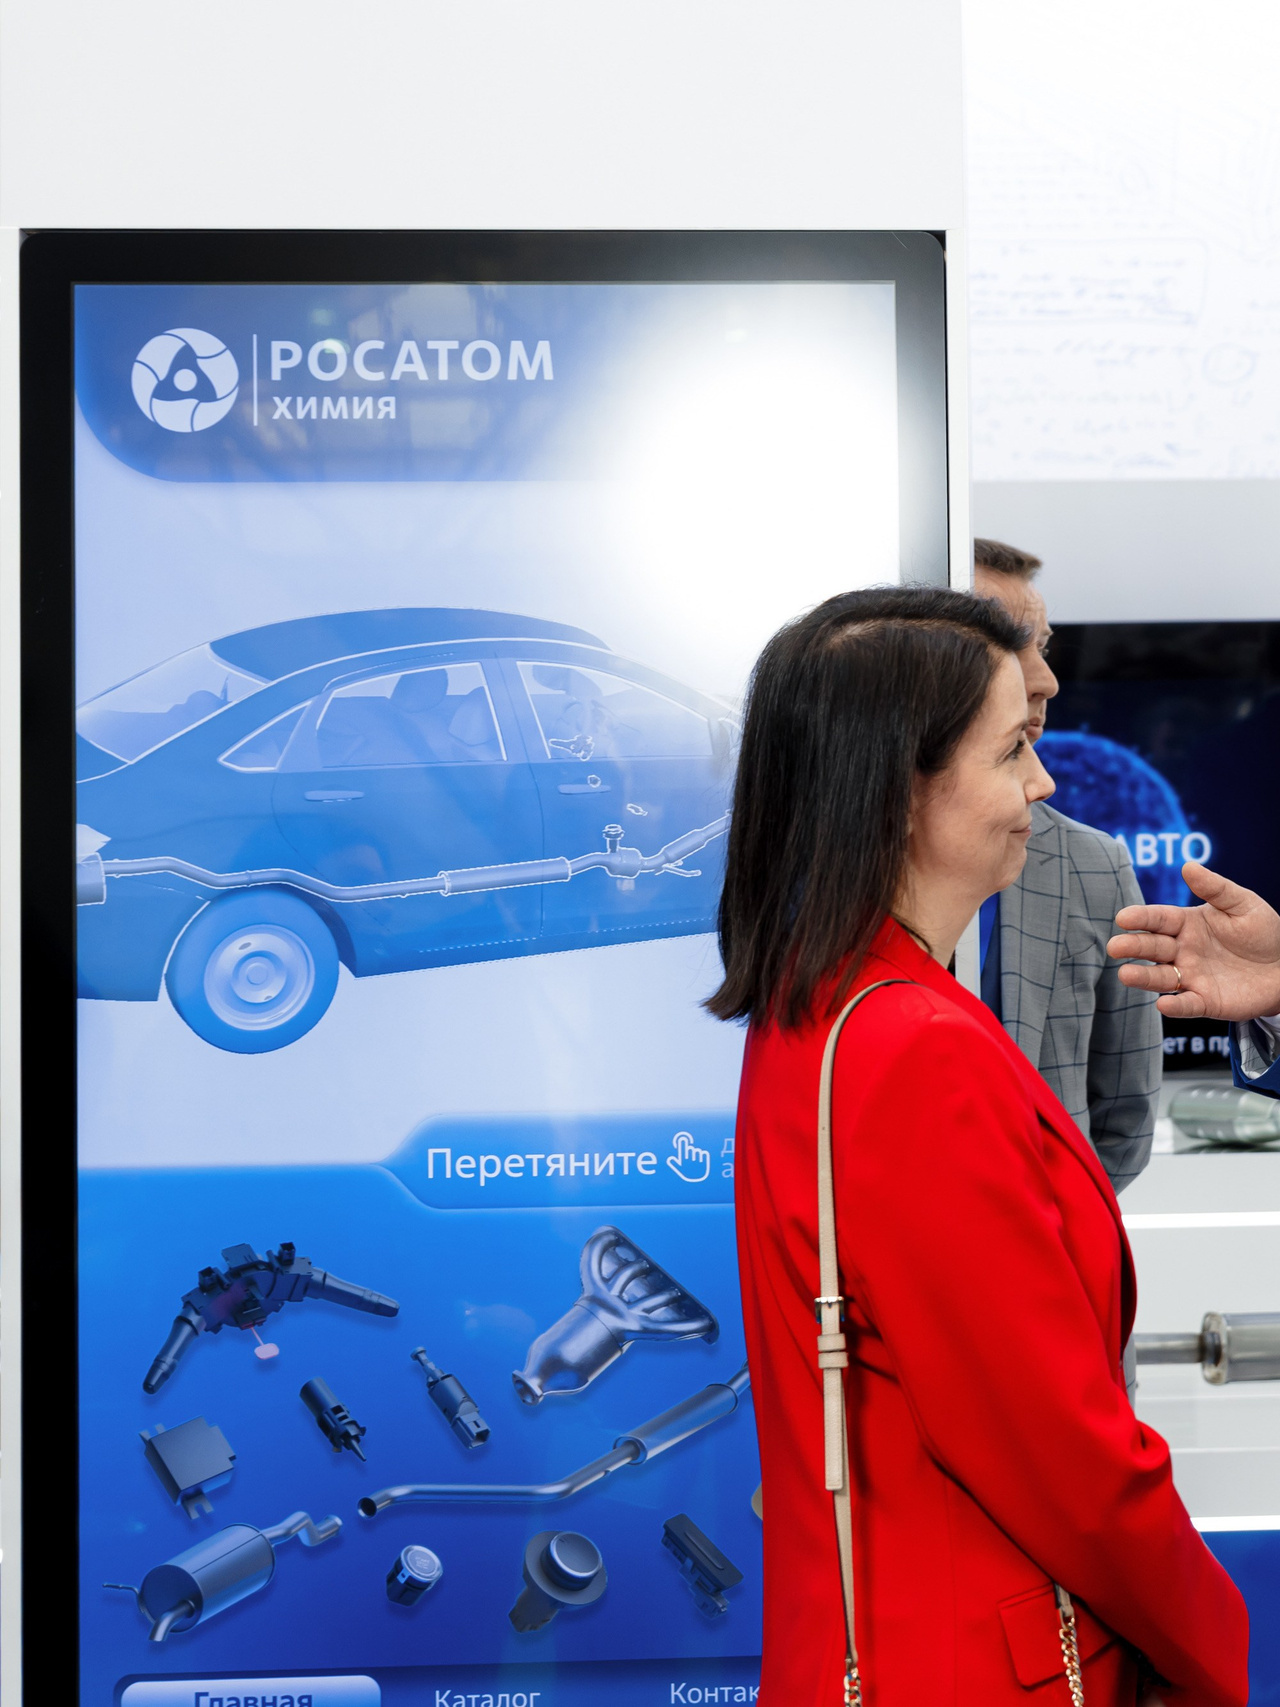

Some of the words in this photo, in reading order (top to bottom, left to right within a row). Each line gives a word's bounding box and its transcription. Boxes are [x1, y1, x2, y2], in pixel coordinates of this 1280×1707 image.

[270, 340, 555, 381] РОСАТОМ
[272, 396, 397, 420] ХИМИЯ
[427, 1148, 658, 1186] Перетяните
[195, 1692, 313, 1707] Главная
[435, 1690, 541, 1707] Каталог
